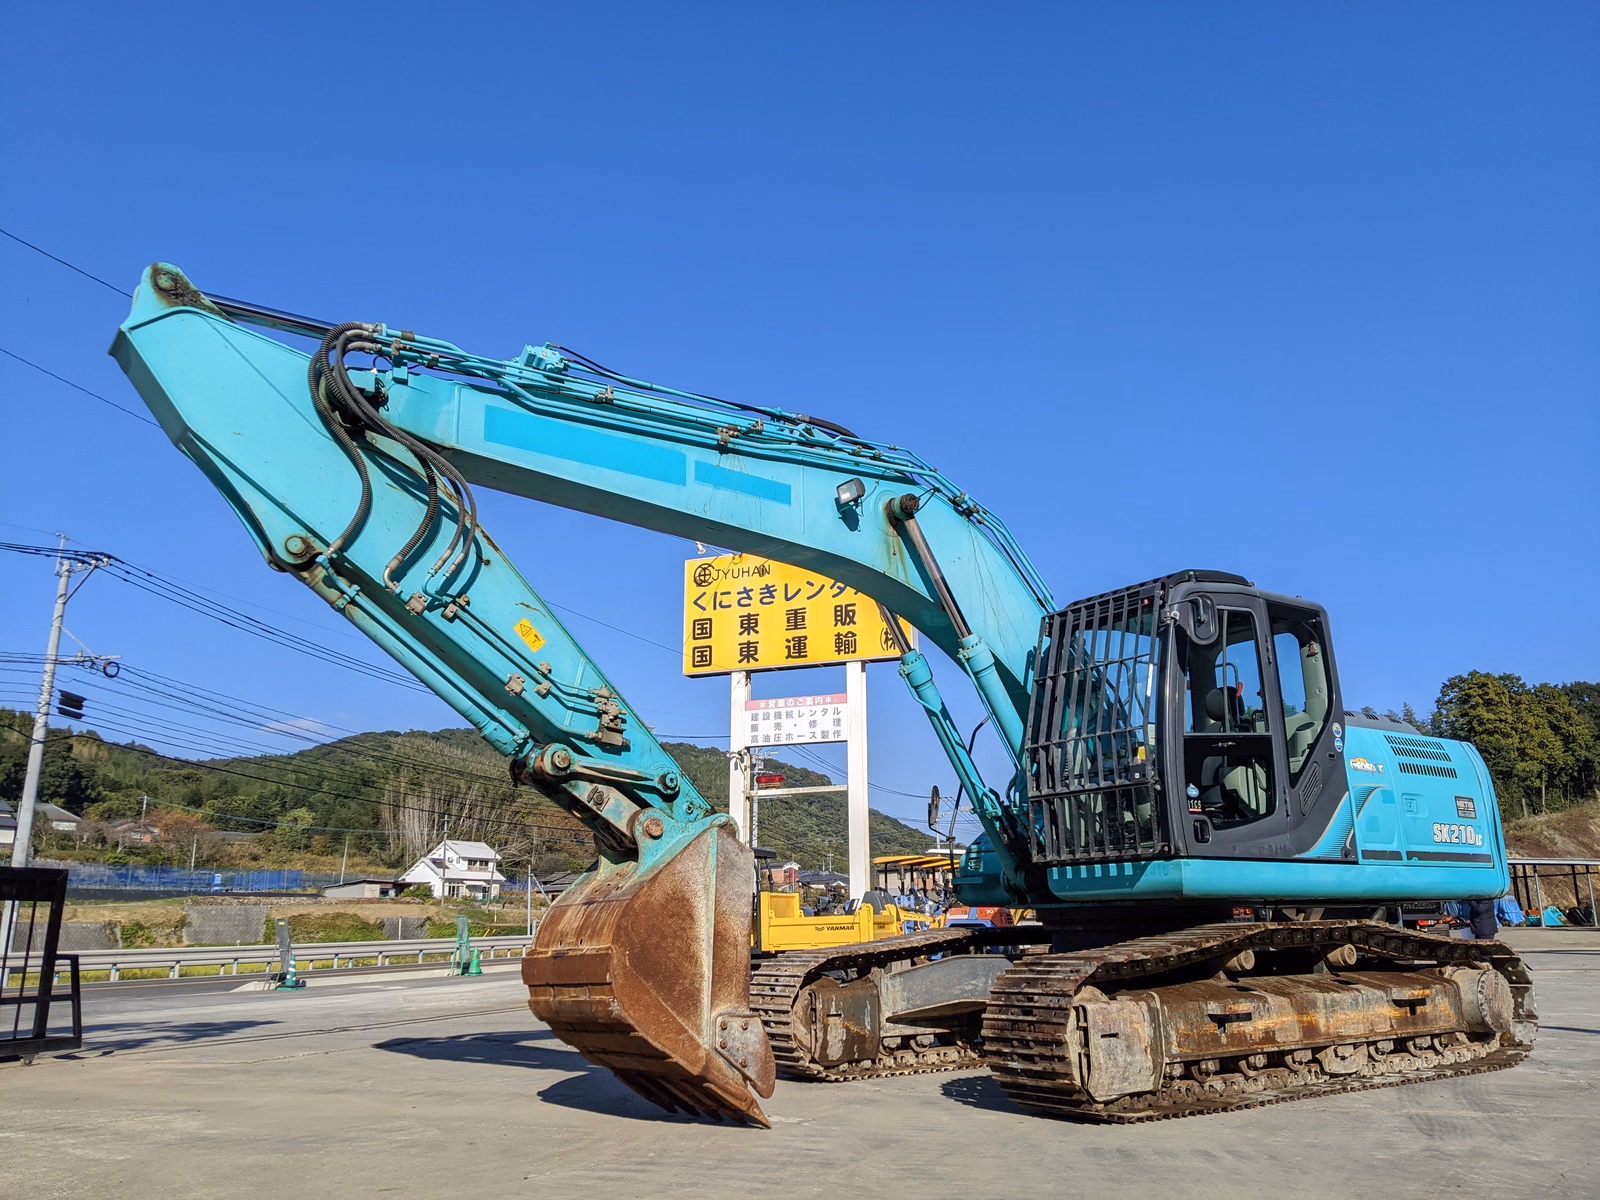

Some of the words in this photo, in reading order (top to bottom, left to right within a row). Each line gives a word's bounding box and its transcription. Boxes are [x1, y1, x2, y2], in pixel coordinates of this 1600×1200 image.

[711, 564, 771, 582] JYUHAN
[750, 706, 842, 722] 建設機械レンタル
